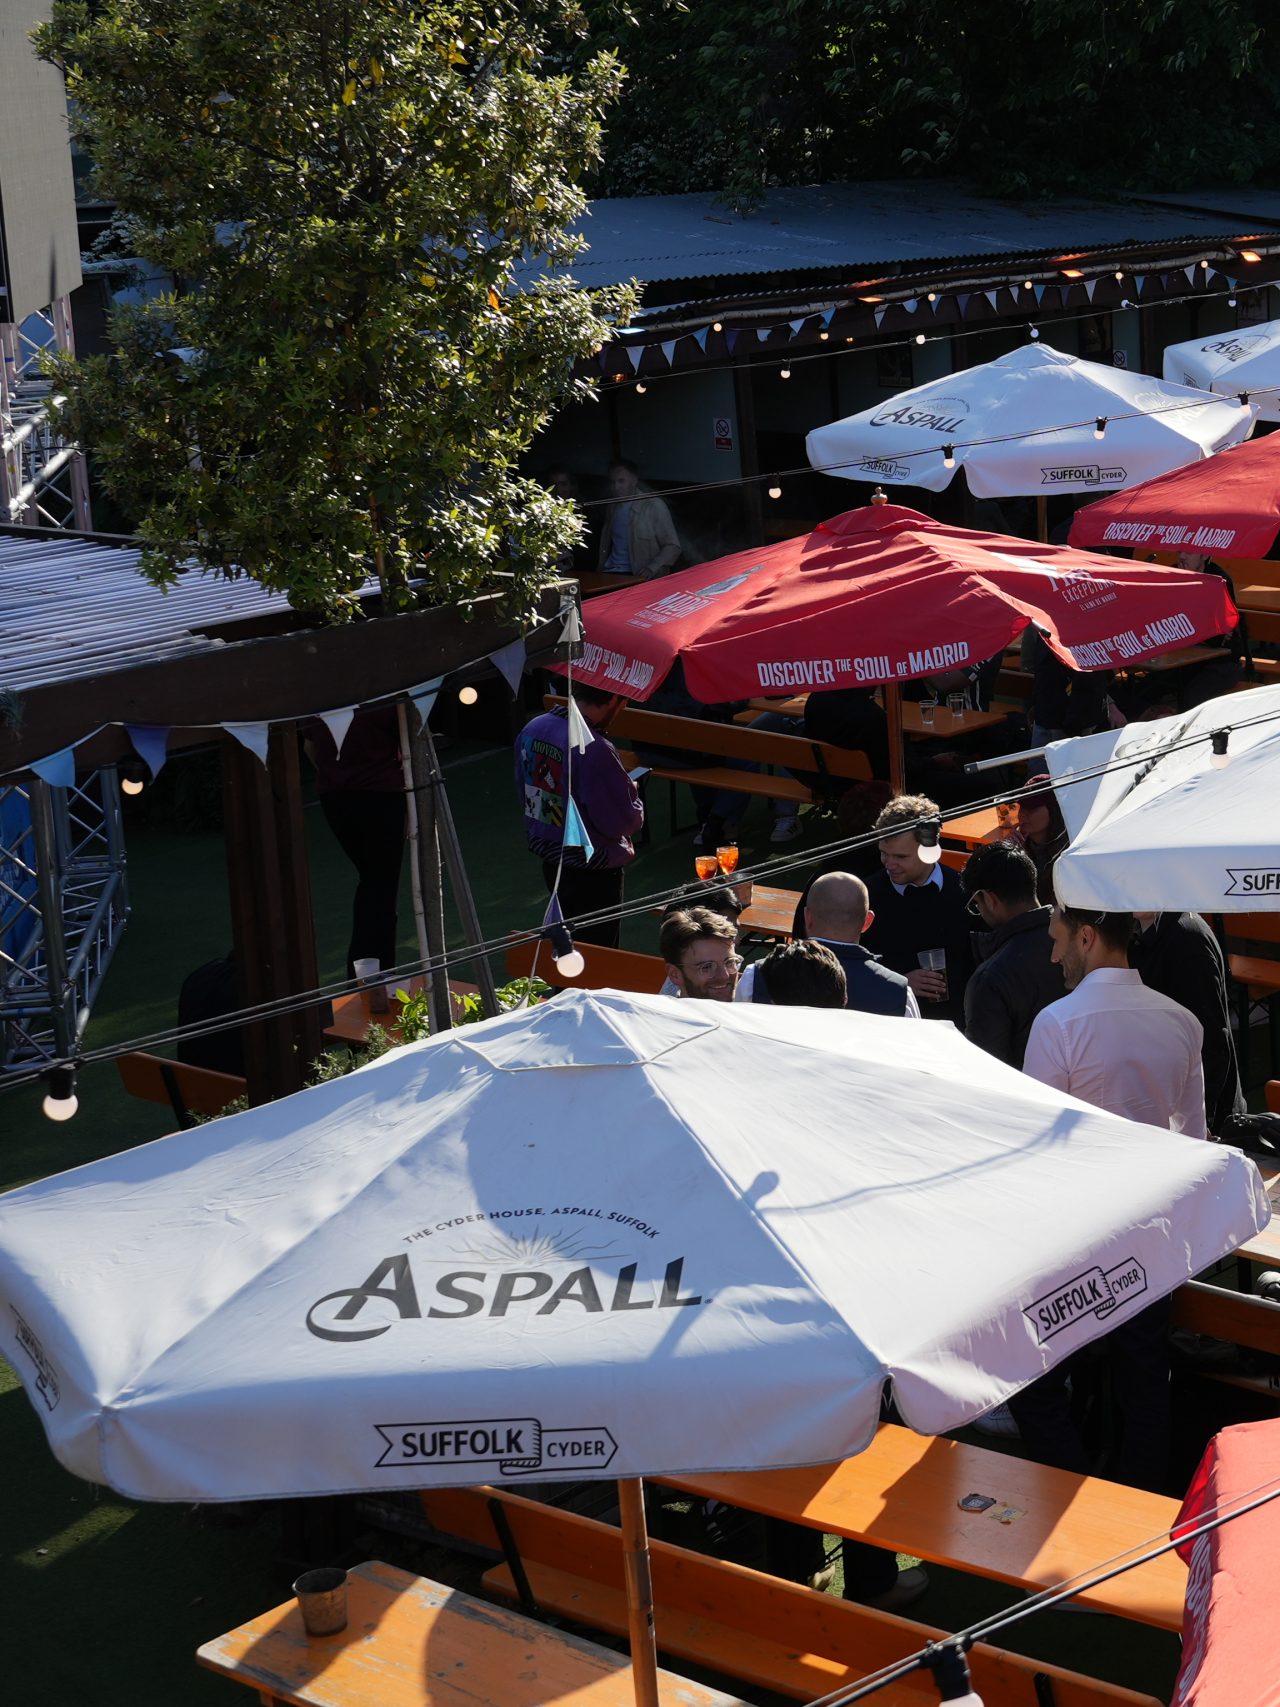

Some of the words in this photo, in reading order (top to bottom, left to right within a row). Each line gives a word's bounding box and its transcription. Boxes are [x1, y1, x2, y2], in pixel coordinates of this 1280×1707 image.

[870, 406, 968, 434] ASPALL
[1050, 469, 1094, 482] SUFFOLK
[1102, 522, 1156, 542] DISCOVER
[1160, 525, 1189, 545] SOUL
[1191, 526, 1236, 550] MADRID
[1070, 641, 1113, 667] SCOVER
[1112, 630, 1149, 659] SOUL
[1145, 613, 1196, 647] MADRID
[604, 651, 626, 682] SOUL
[757, 659, 836, 687] DISCOVER
[834, 658, 853, 673] THE
[853, 655, 896, 681] SOUL
[897, 661, 908, 676] OF
[908, 641, 969, 674] MADRID
[402, 1225, 433, 1244] THE
[434, 1213, 486, 1232] CYDER
[489, 1208, 547, 1222] HOUSE,
[607, 1211, 660, 1239] SUFFOLK
[306, 1252, 703, 1343] ASPALL
[1038, 1278, 1104, 1332] SUFFOLK
[1111, 1268, 1142, 1296] CYDER
[402, 1428, 525, 1458] SUFFOLK
[546, 1440, 607, 1458] CYDER
